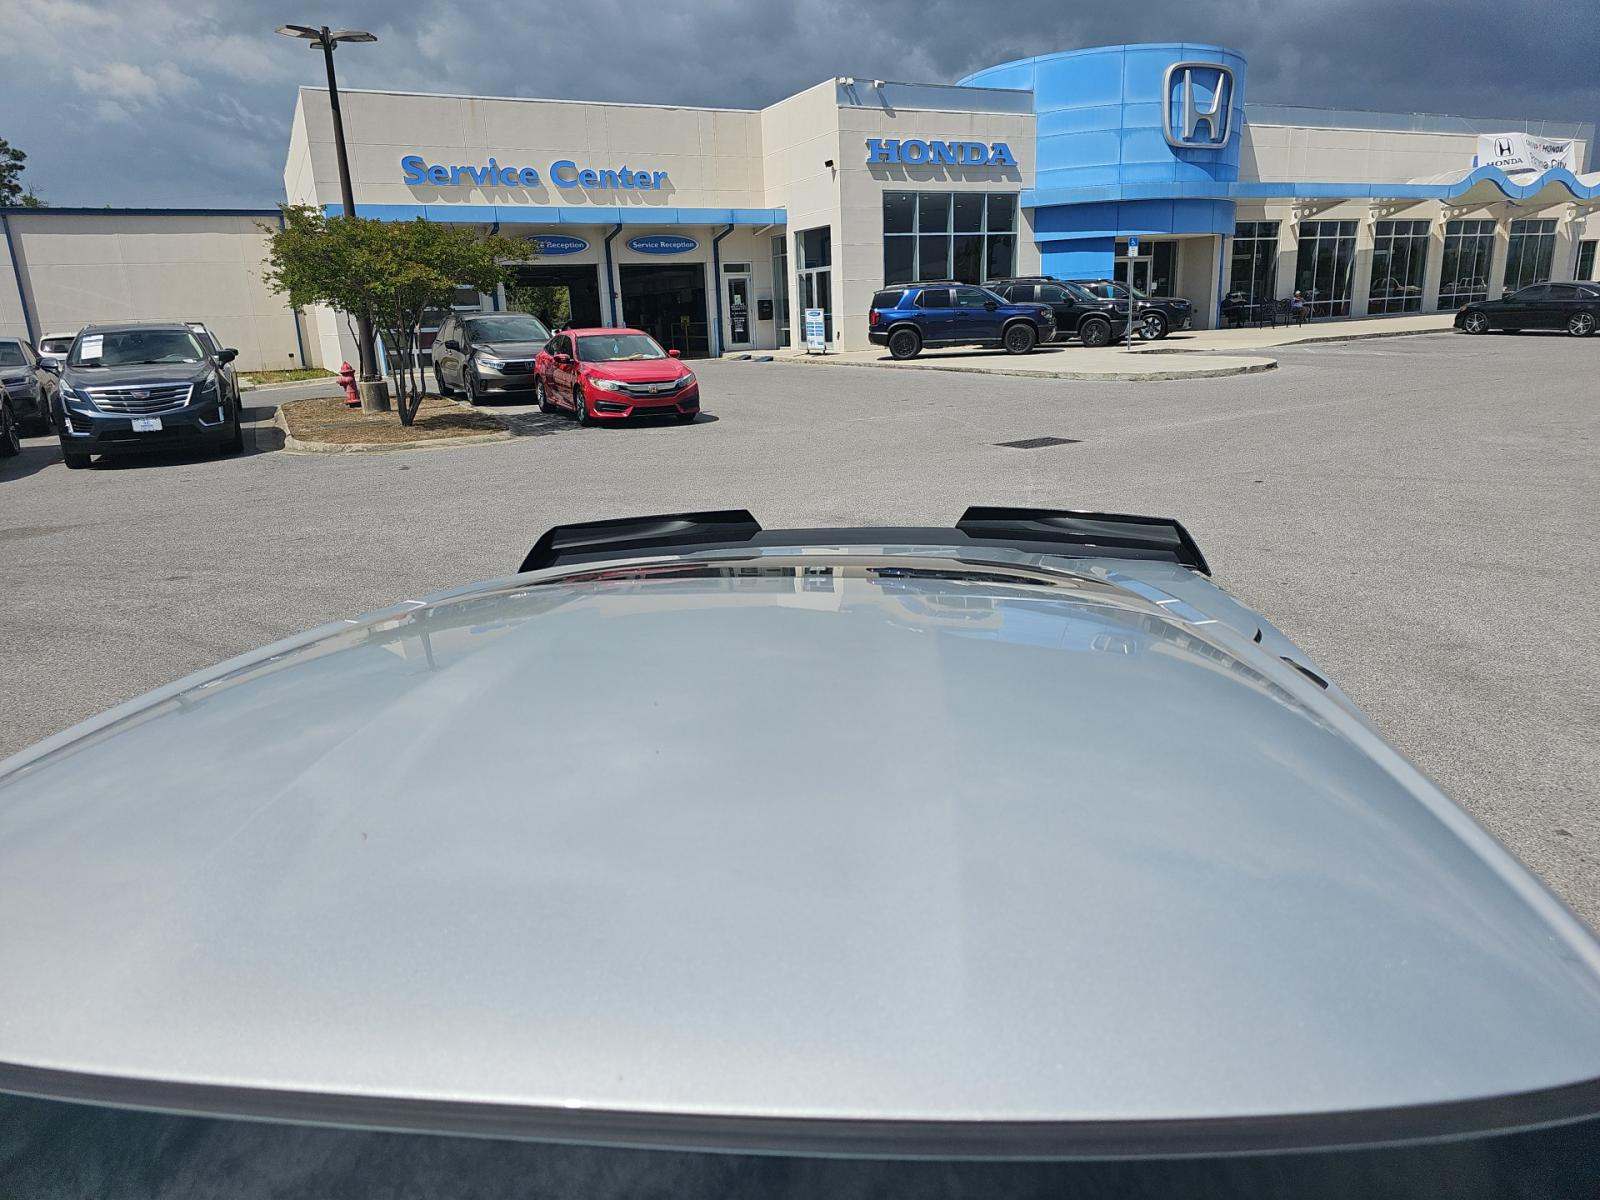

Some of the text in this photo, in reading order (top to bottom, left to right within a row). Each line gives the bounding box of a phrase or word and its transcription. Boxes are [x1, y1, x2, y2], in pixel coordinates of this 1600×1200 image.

[866, 138, 1018, 167] HONDA
[401, 155, 668, 191] Service Center
[546, 242, 585, 250] Reception
